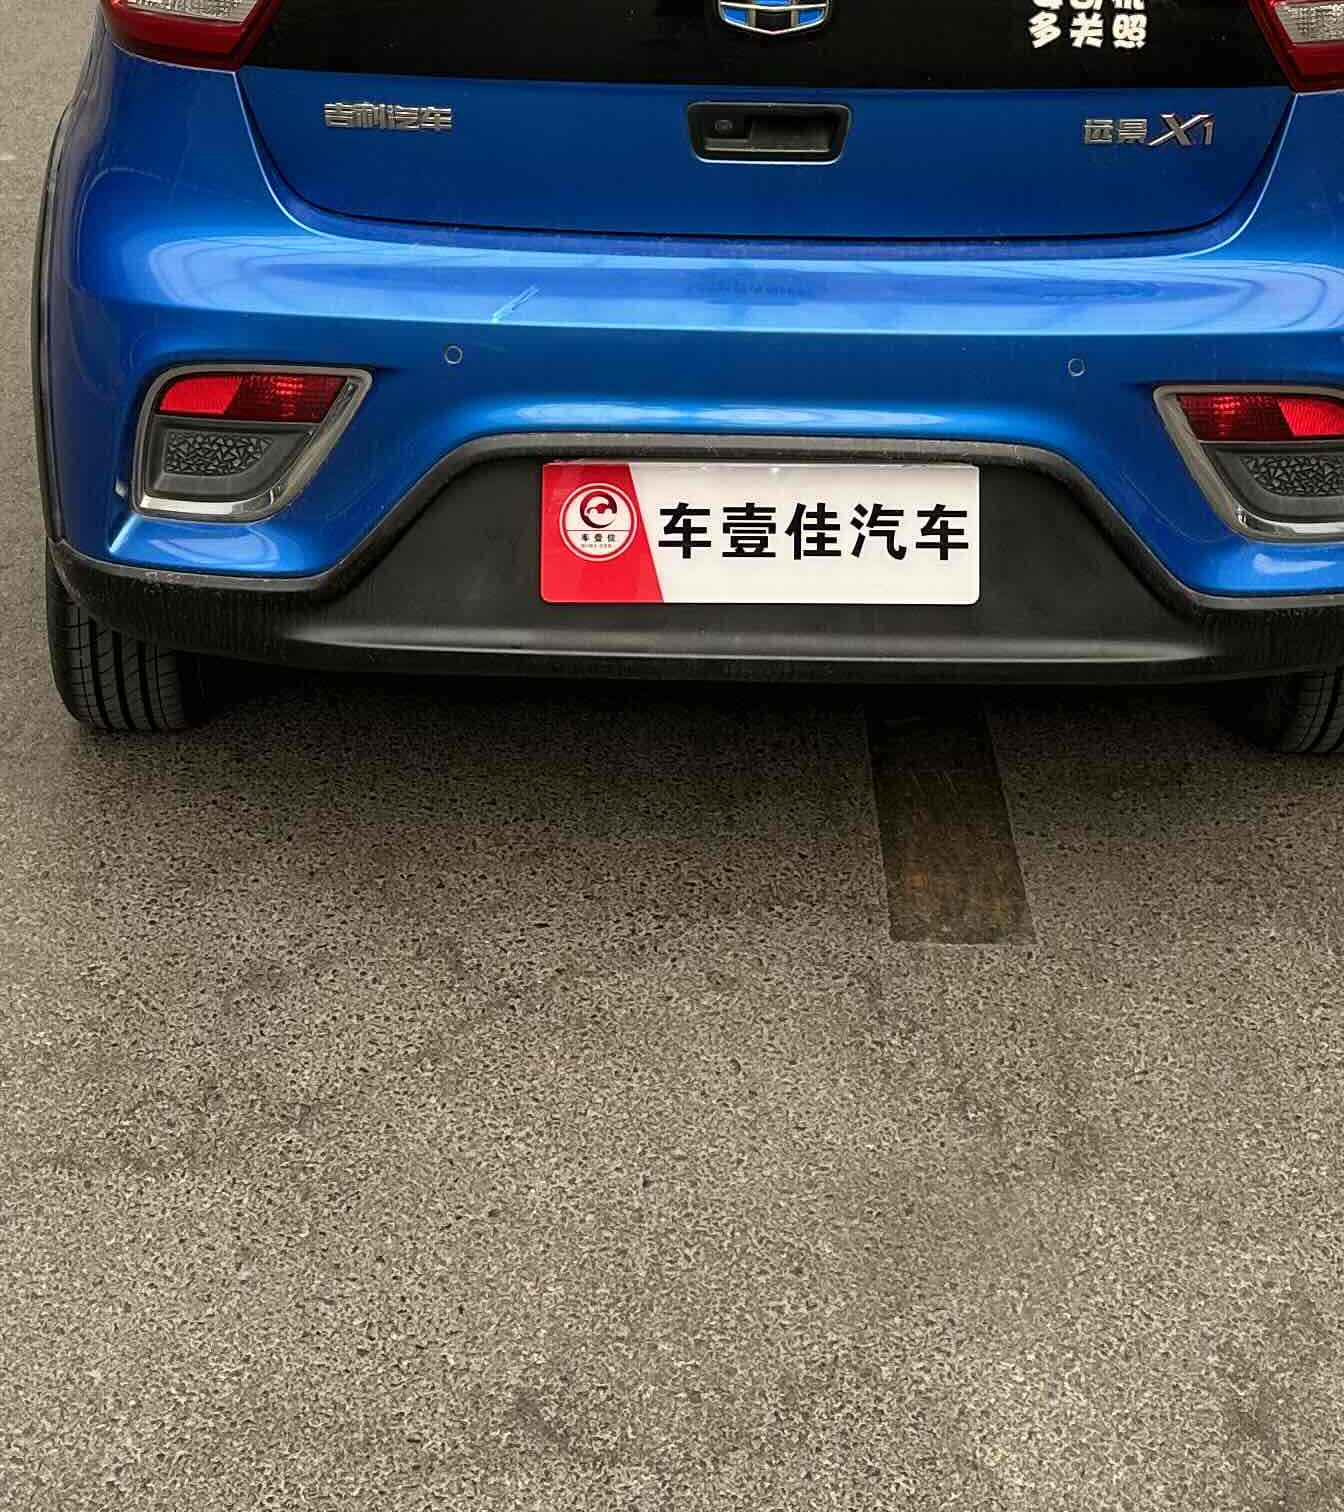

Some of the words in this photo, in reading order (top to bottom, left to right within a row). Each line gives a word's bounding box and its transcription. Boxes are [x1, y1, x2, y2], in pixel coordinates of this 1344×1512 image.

[1028, 11, 1147, 49] 多关照
[324, 102, 452, 131] 吉利汽车
[658, 502, 969, 561] 车壹佳汽车
